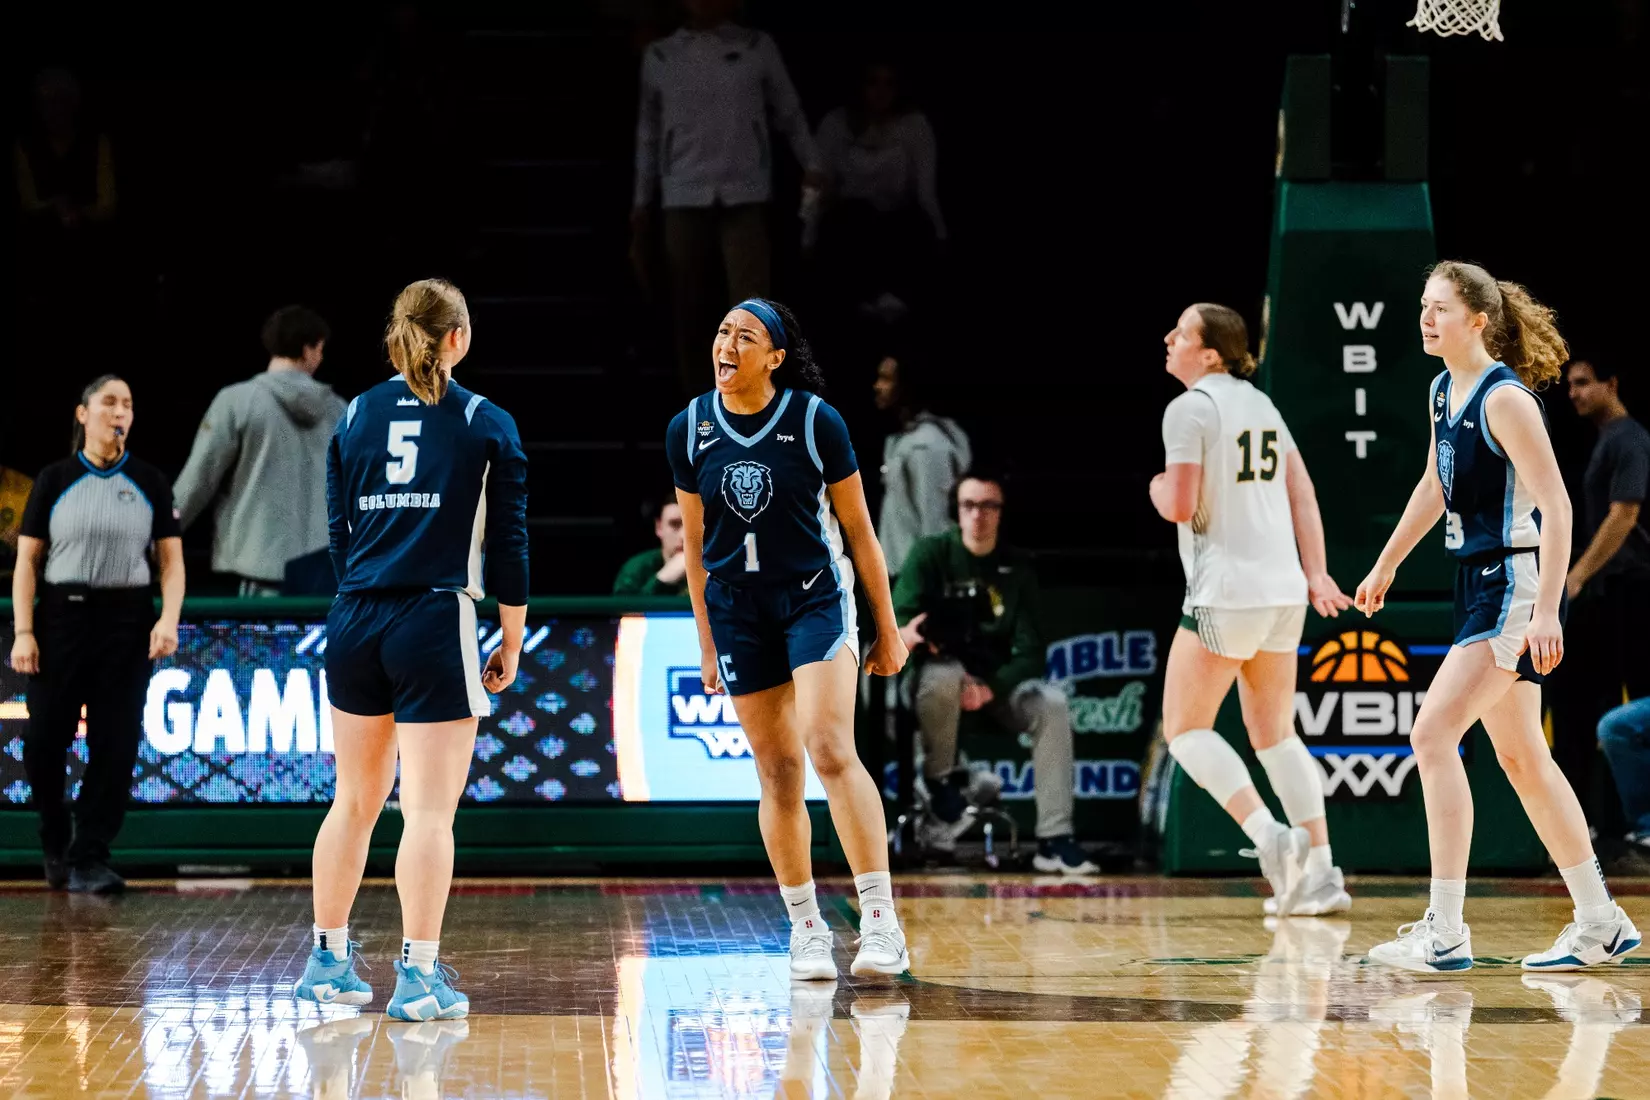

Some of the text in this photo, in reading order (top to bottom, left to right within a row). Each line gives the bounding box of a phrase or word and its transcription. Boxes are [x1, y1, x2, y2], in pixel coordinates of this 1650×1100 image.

[1333, 302, 1385, 459] WBIT
[385, 420, 422, 485] 5
[1236, 430, 1278, 483] 15
[358, 492, 441, 511] COLUMBIA
[743, 532, 760, 572] 1
[1292, 690, 1428, 737] WBI
